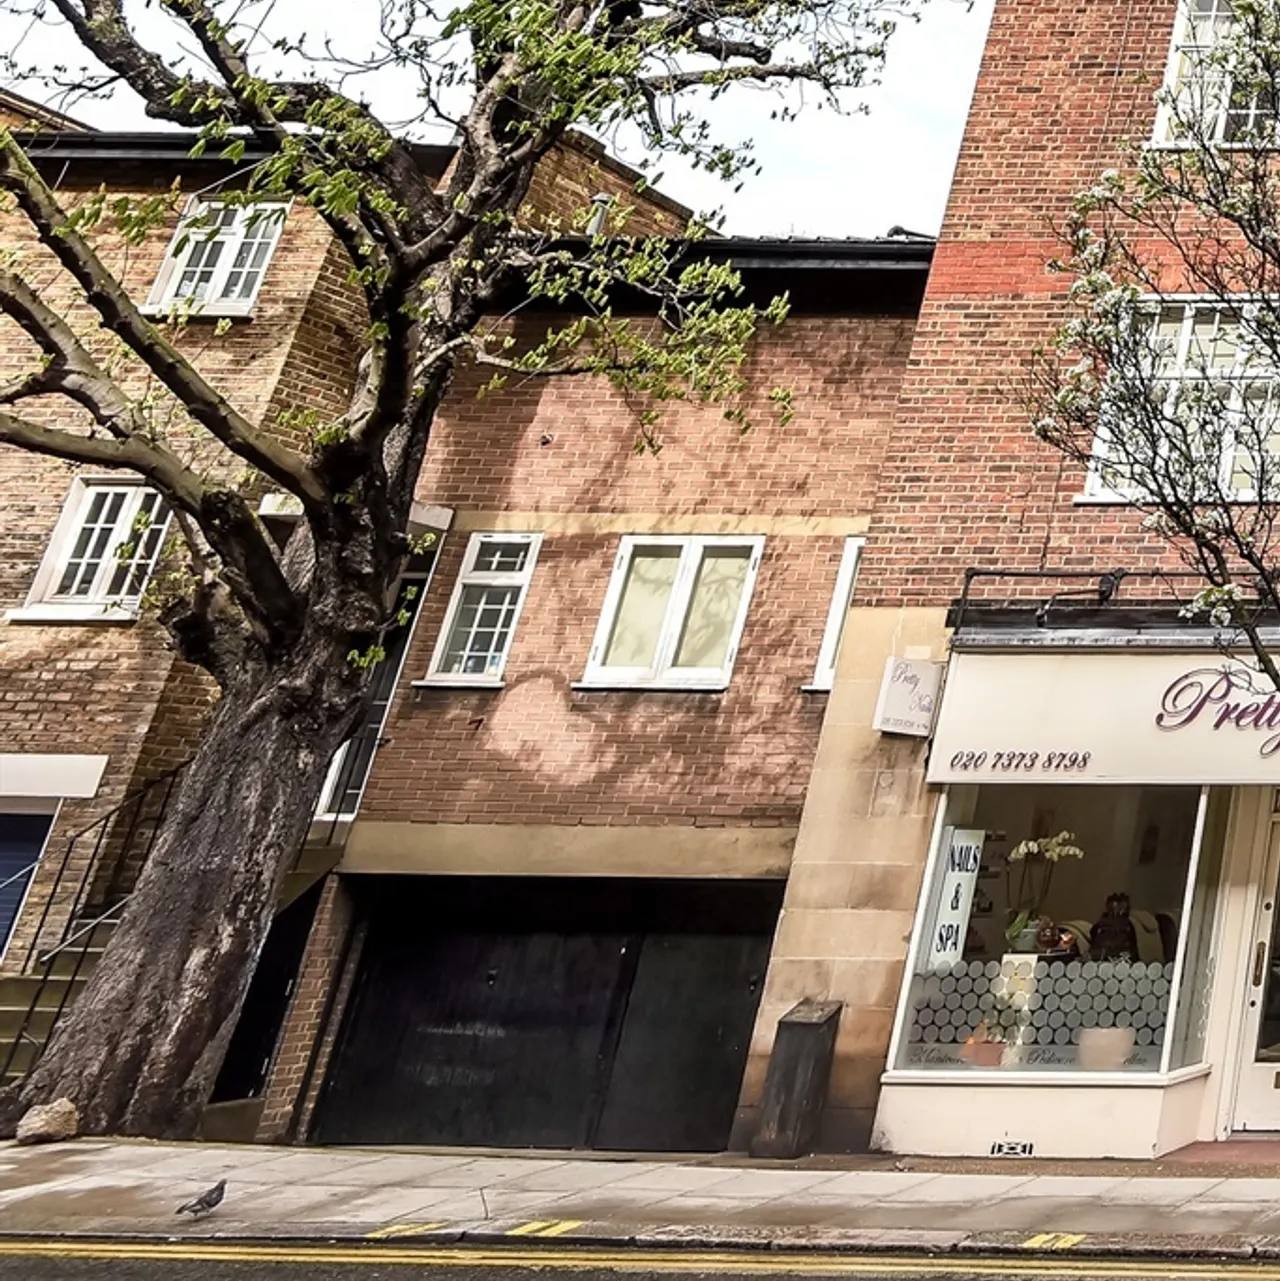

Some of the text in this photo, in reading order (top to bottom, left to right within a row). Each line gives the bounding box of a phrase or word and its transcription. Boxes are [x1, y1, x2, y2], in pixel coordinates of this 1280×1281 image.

[949, 750, 1092, 772] 020 7373 8798
[950, 882, 962, 911] &
[936, 923, 961, 953] SPA
